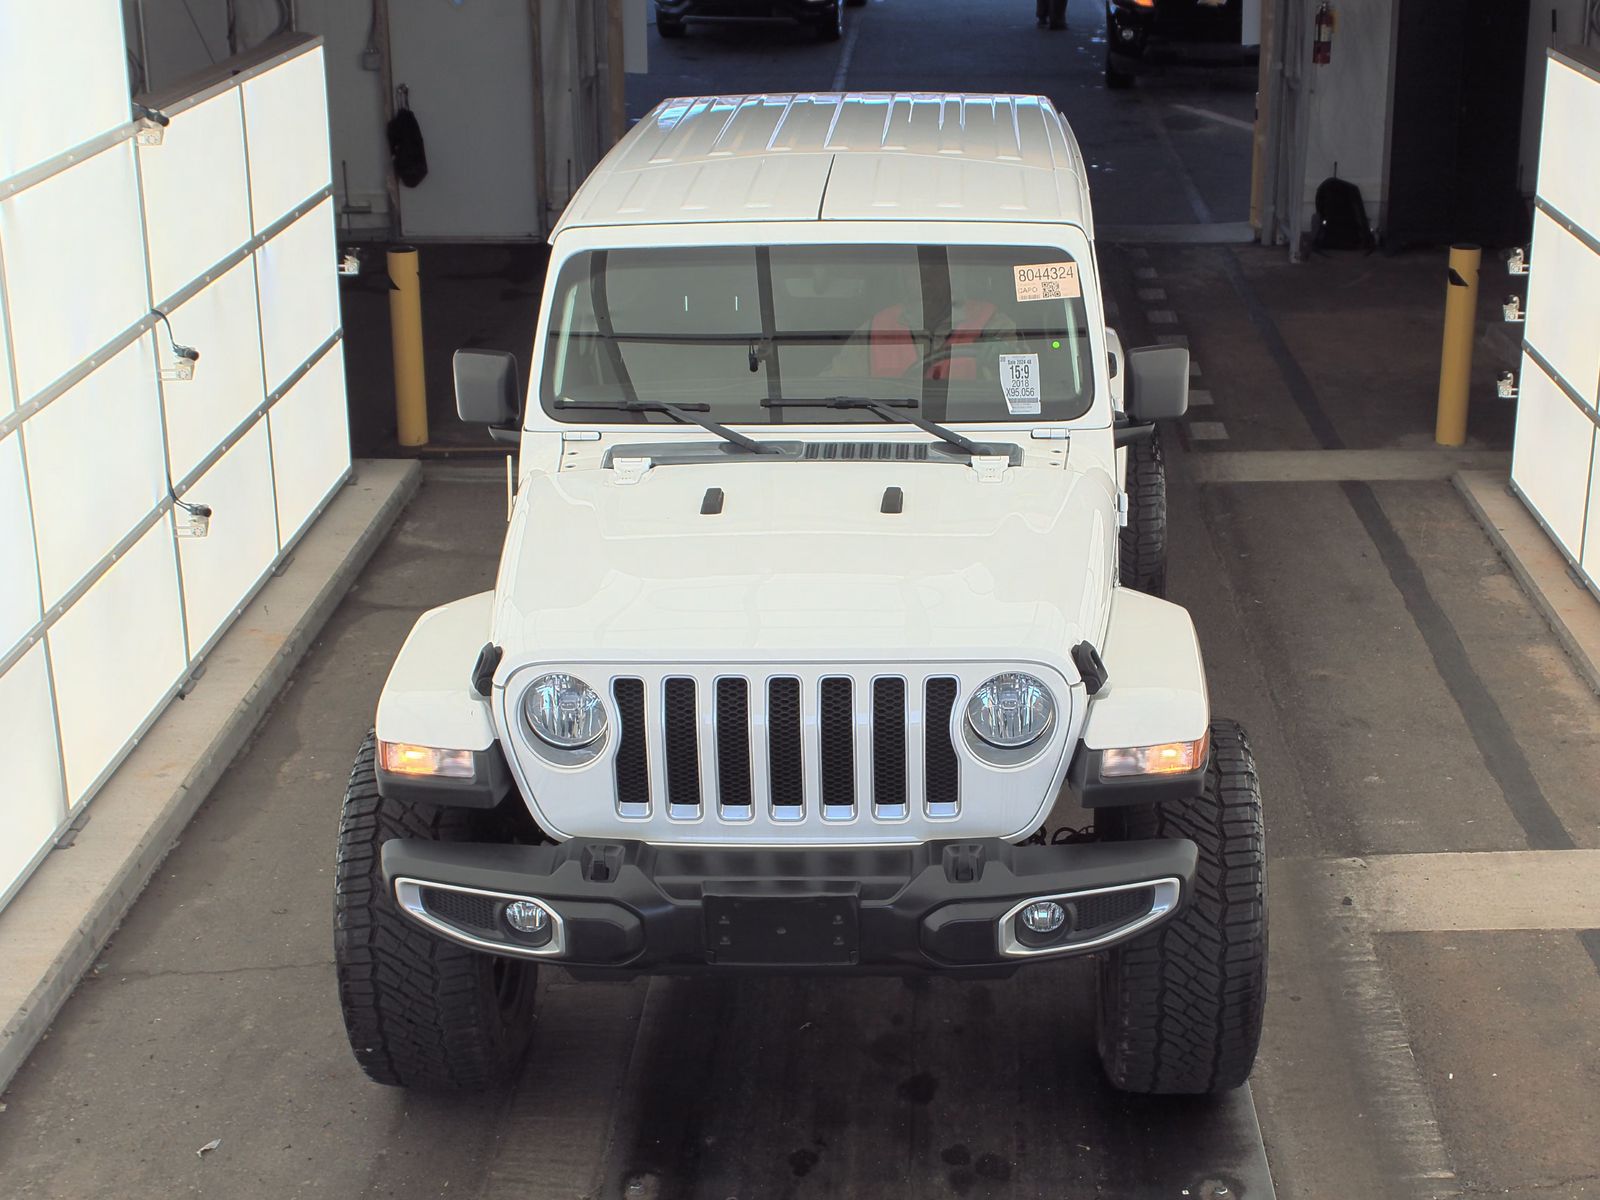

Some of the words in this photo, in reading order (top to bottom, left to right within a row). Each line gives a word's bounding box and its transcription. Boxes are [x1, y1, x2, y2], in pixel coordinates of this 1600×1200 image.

[1018, 265, 1074, 282] 8044324
[1009, 365, 1030, 379] 15:9
[1011, 379, 1030, 388] 2018
